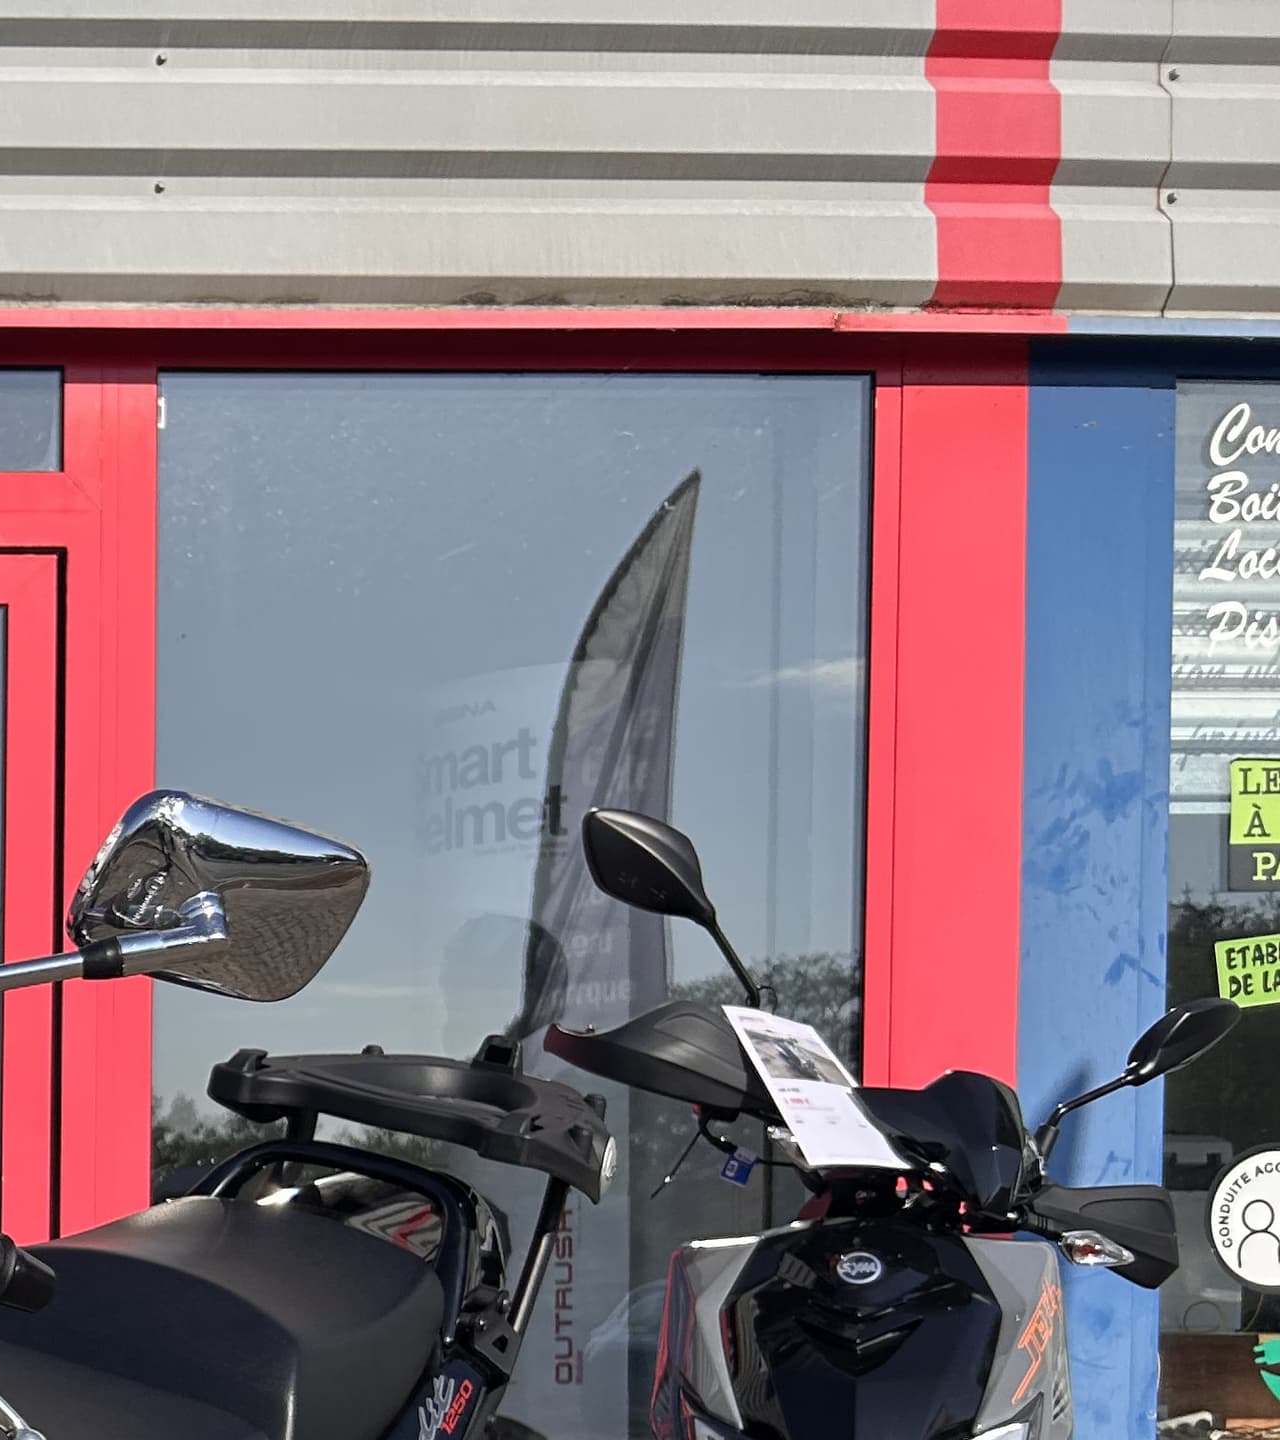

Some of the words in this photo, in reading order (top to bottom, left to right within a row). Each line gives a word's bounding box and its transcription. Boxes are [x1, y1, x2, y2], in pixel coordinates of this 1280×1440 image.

[1206, 470, 1280, 525] Boi
[1198, 528, 1280, 582] Loc
[418, 727, 538, 795] mart
[418, 783, 569, 856] elmet
[1243, 802, 1271, 838] À
[1225, 941, 1280, 970] ETAB
[1228, 973, 1254, 999] DE
[1218, 1172, 1252, 1249] CONDUITE
[439, 1378, 474, 1436] 1250
